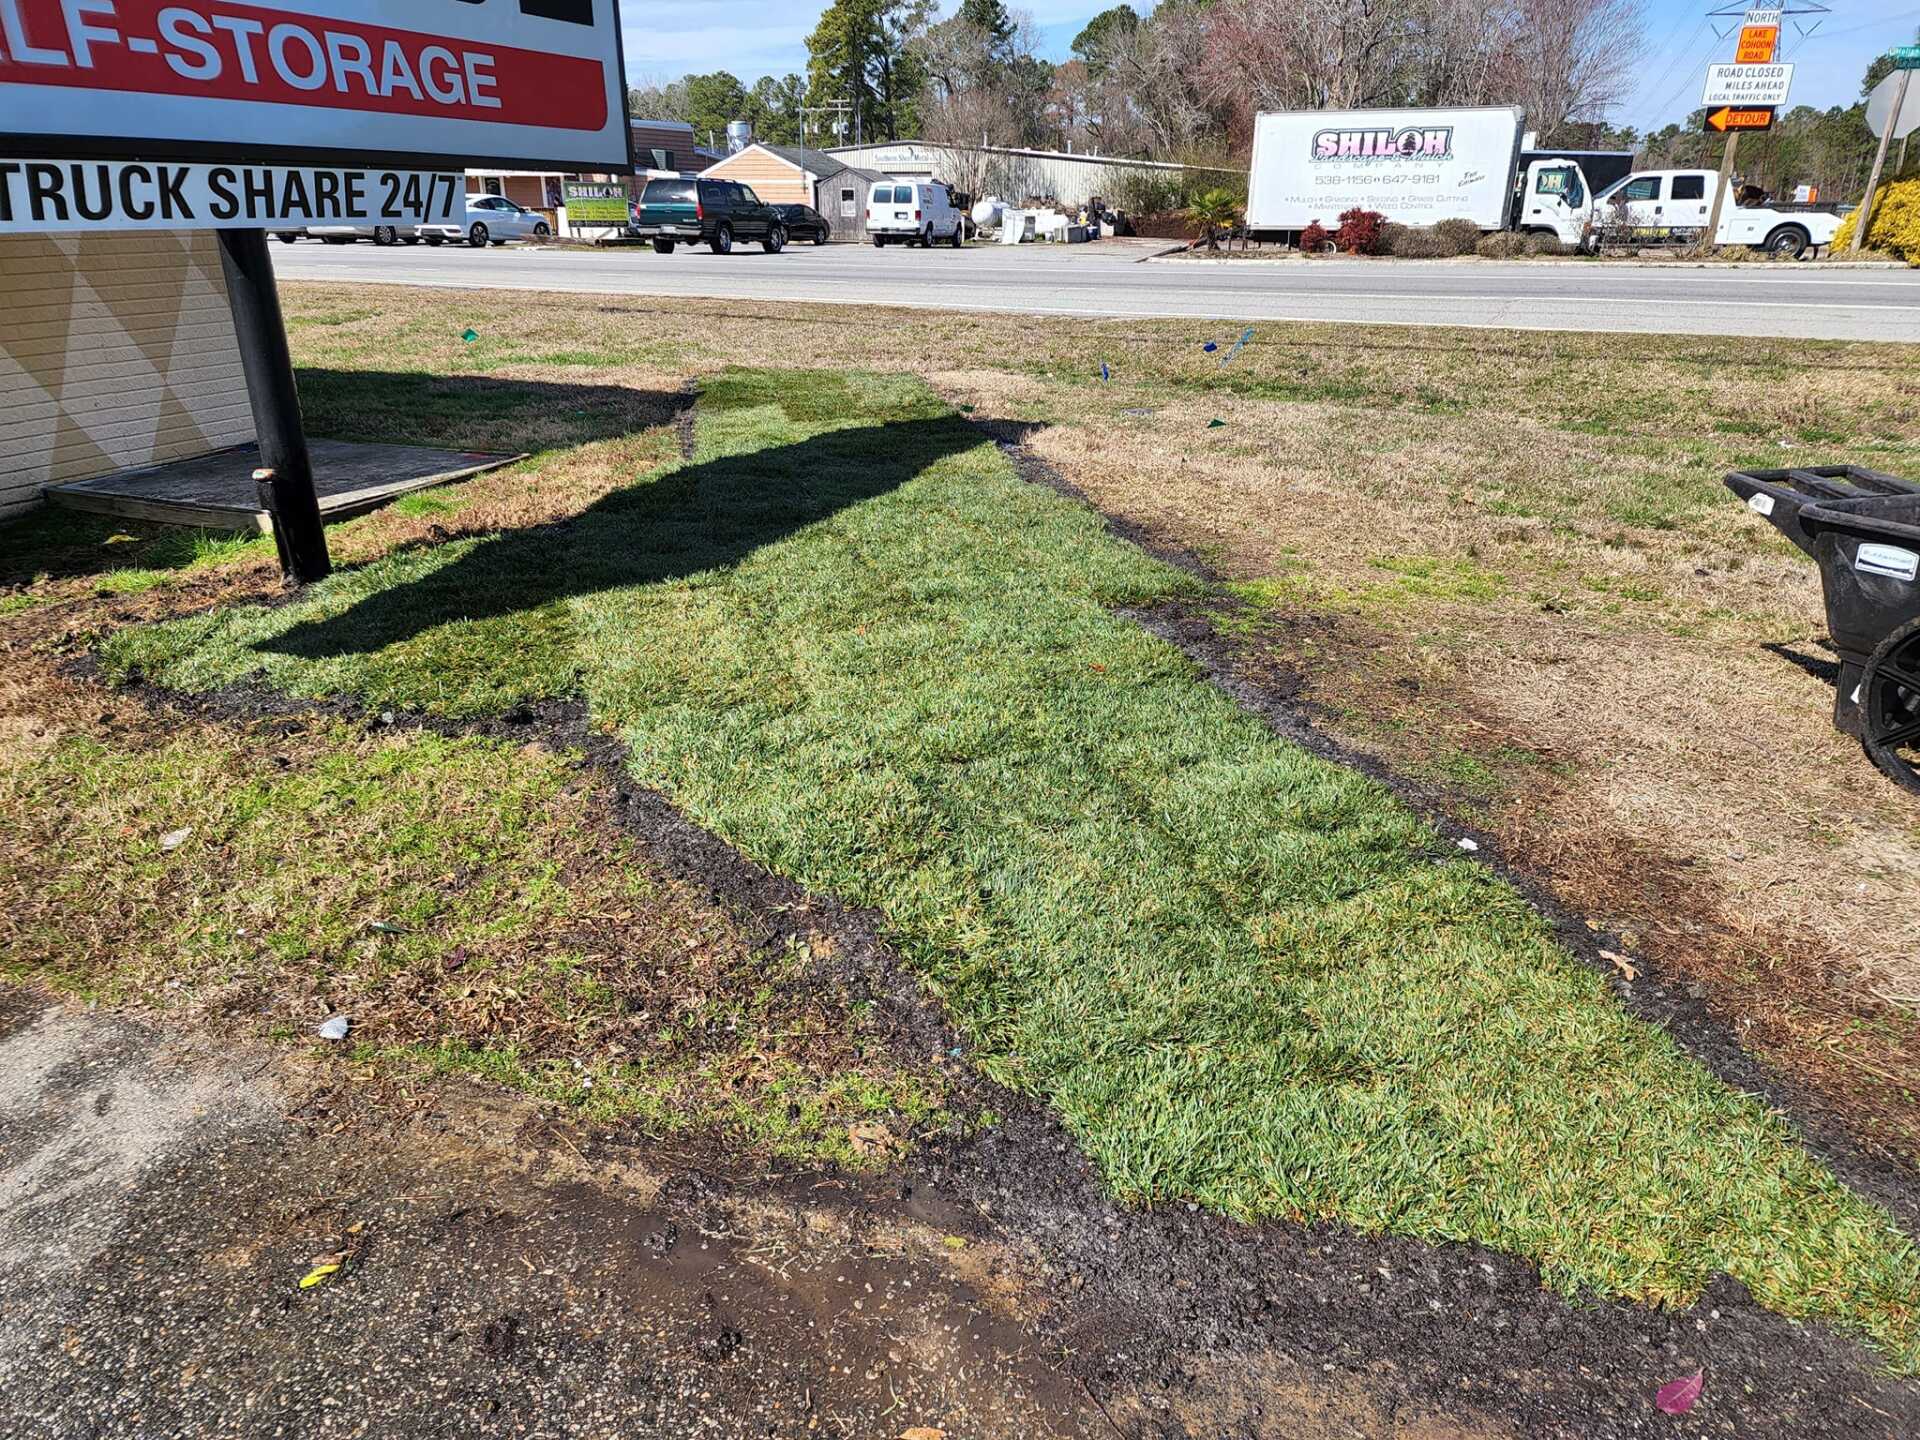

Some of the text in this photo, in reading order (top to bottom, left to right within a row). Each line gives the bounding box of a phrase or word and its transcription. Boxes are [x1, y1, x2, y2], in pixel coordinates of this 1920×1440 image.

[1746, 12, 1779, 23] NORTH
[1749, 30, 1768, 38] LAKE
[0, 0, 502, 108] LF-STORAGE
[1743, 51, 1764, 59] ROAD
[1717, 67, 1784, 78] ROAD CLOSED
[1725, 81, 1784, 90] MILES AHEAD
[1709, 93, 1782, 101] LOCAL TRAFFIC ONLY
[1726, 112, 1767, 124] DETOUR
[1316, 130, 1449, 157] SHILOH
[0, 162, 457, 224] TRUCK SHARE 24/7
[568, 185, 623, 198] SHILOH
